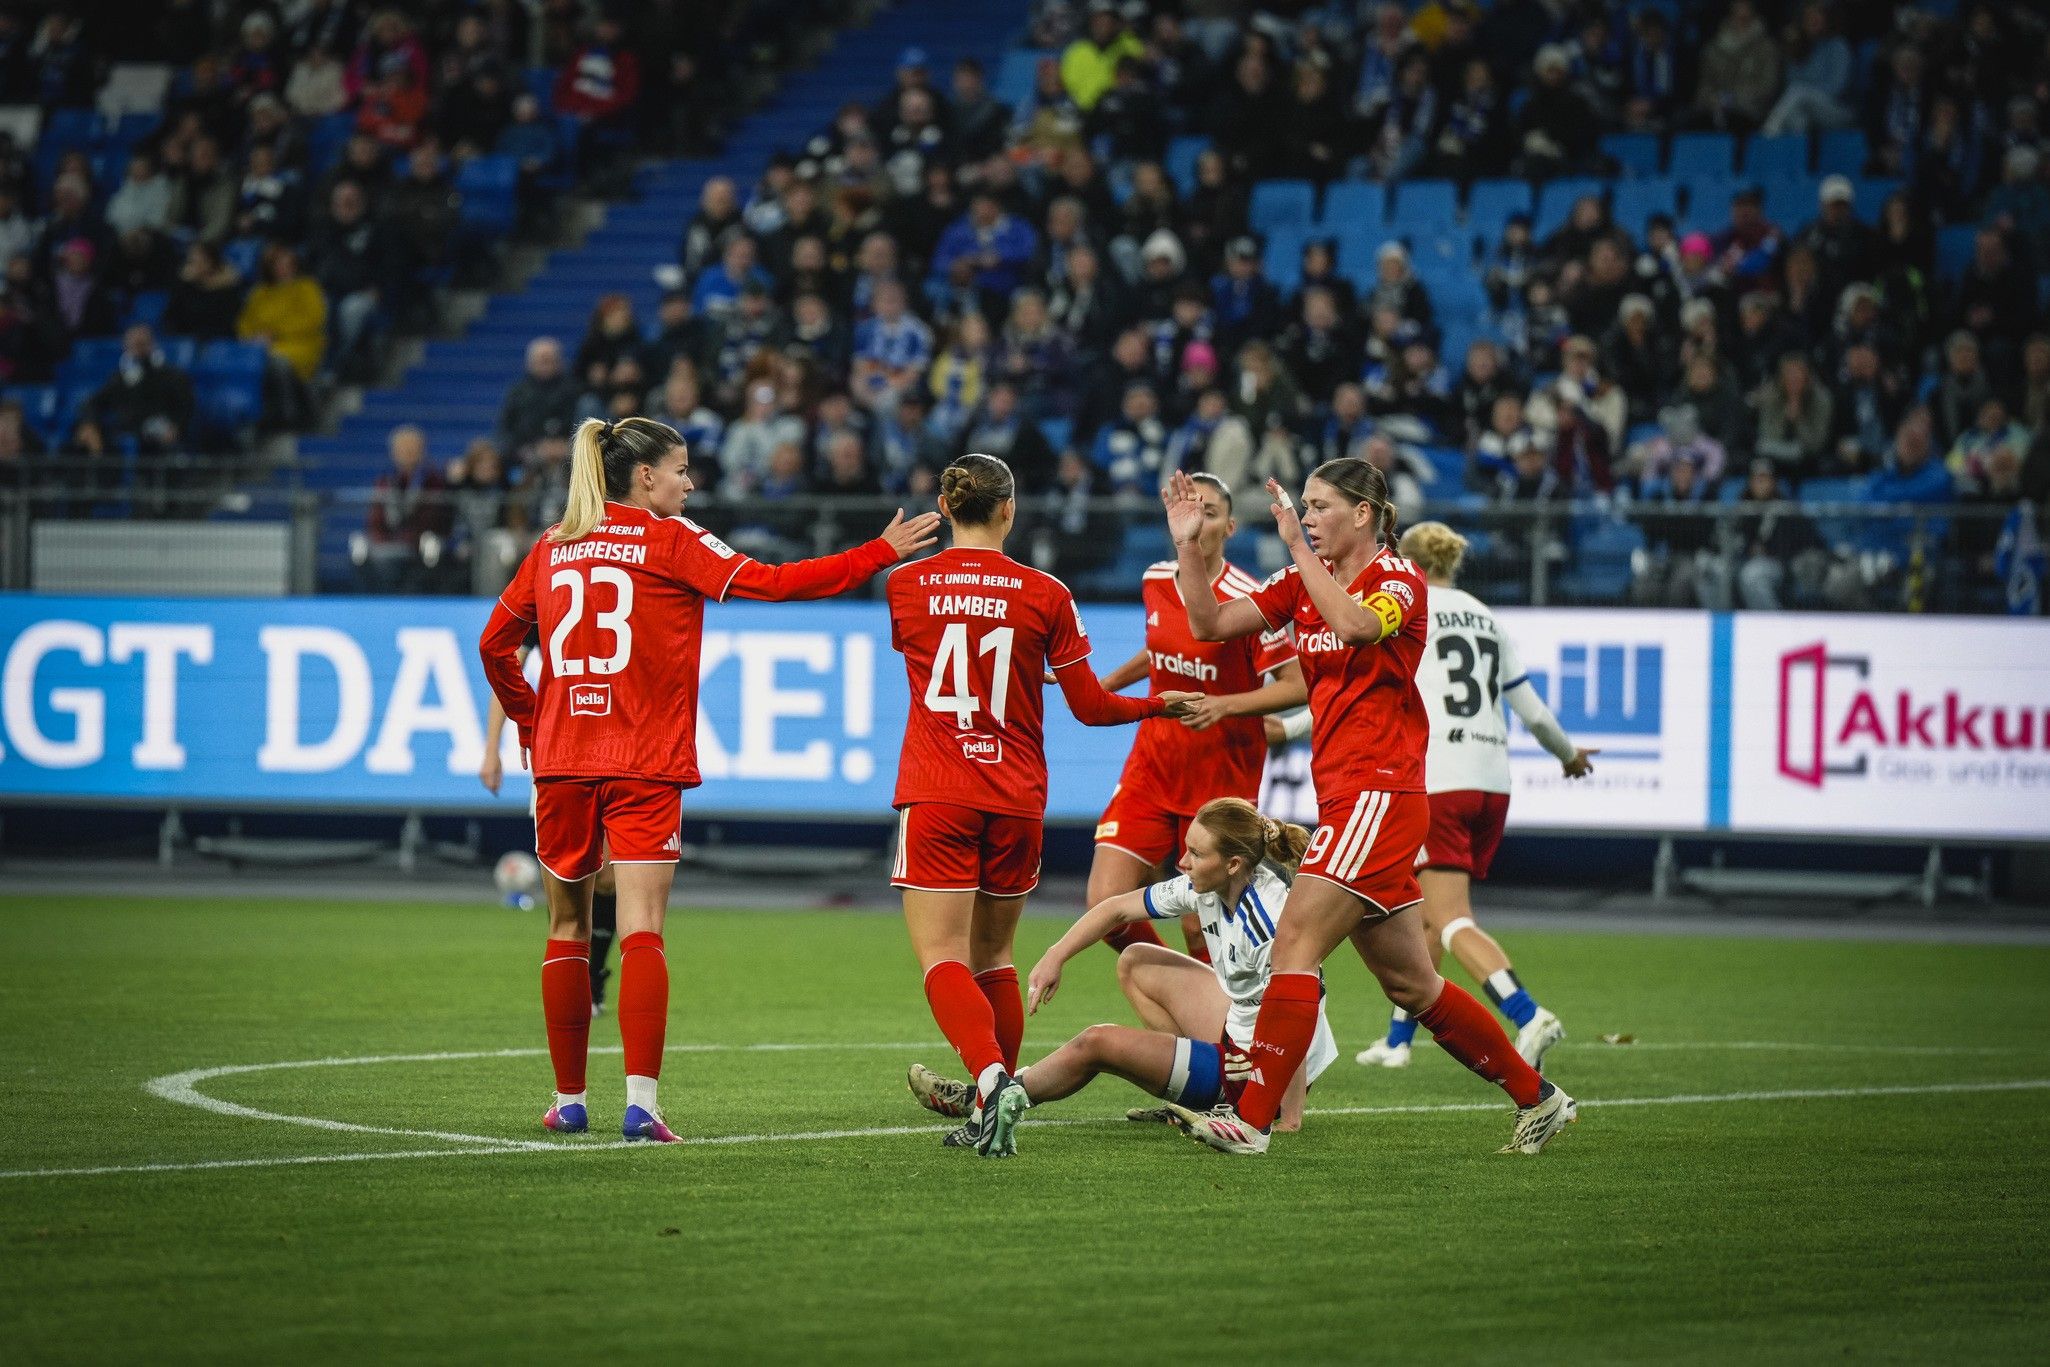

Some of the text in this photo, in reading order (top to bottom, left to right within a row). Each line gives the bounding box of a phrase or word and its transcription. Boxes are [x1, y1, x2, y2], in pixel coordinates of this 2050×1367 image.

[608, 525, 645, 536] BERLIN
[550, 541, 647, 566] BAUEREISEN
[929, 574, 943, 585] FC
[944, 574, 980, 586] UNION
[982, 575, 1023, 589] BERLIN
[929, 596, 1008, 619] KAMBER
[549, 566, 634, 678] 23
[1435, 610, 1497, 635] BARTZ
[924, 623, 1015, 729] 41
[1155, 652, 1217, 681] raisin
[1436, 634, 1500, 718] 37
[0, 620, 213, 769] GT
[576, 693, 604, 705] bella
[963, 742, 995, 753] bella
